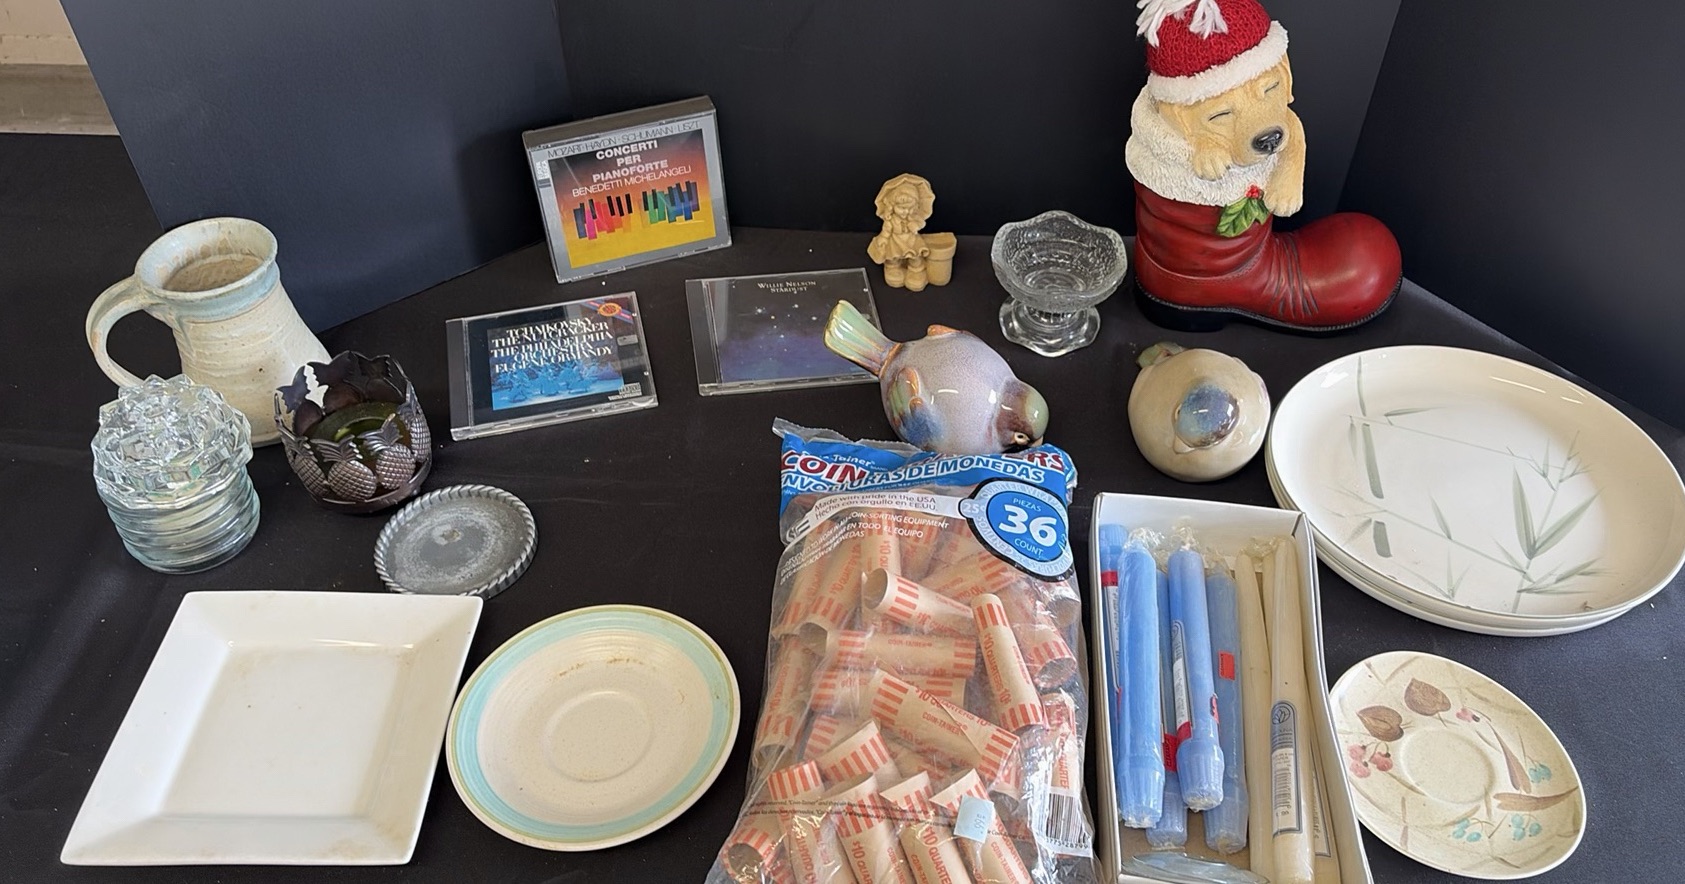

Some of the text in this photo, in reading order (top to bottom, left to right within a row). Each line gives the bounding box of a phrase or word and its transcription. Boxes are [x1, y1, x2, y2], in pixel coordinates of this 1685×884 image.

[586, 137, 617, 151] HAYDN
[622, 126, 674, 142] SCHUMANN
[677, 121, 700, 133] LISZT
[595, 139, 658, 160] CONCERTI
[592, 159, 668, 183] PIANOFORTE
[616, 154, 642, 167] PER
[572, 165, 691, 197] BENEDETTI MICHELANGELI
[756, 280, 817, 289] WILLIE NELSON
[492, 321, 609, 347] THE NUTCRACKER
[506, 317, 594, 338] TCHAIKOVSKY
[490, 331, 613, 358] THE PHILADELPHIA
[514, 341, 594, 362] ORCHESTRA
[550, 346, 613, 363] ORMANDY
[782, 450, 867, 483] COIN
[908, 462, 935, 479] DE
[938, 456, 1045, 483] MONEDAS
[814, 498, 838, 512] Made
[839, 495, 860, 503] with
[861, 493, 887, 503] pride
[899, 493, 915, 502] the
[916, 496, 936, 504] USA
[815, 502, 841, 520] Hecho
[860, 498, 894, 508] orgullo
[1012, 498, 1042, 512] PIEZAS
[859, 522, 881, 530] TODO
[883, 525, 893, 533] EL
[894, 526, 924, 539] EQUIPO
[903, 517, 949, 529] EQUIPMENT
[998, 504, 1058, 548] 36
[1014, 538, 1044, 556] COUNT
